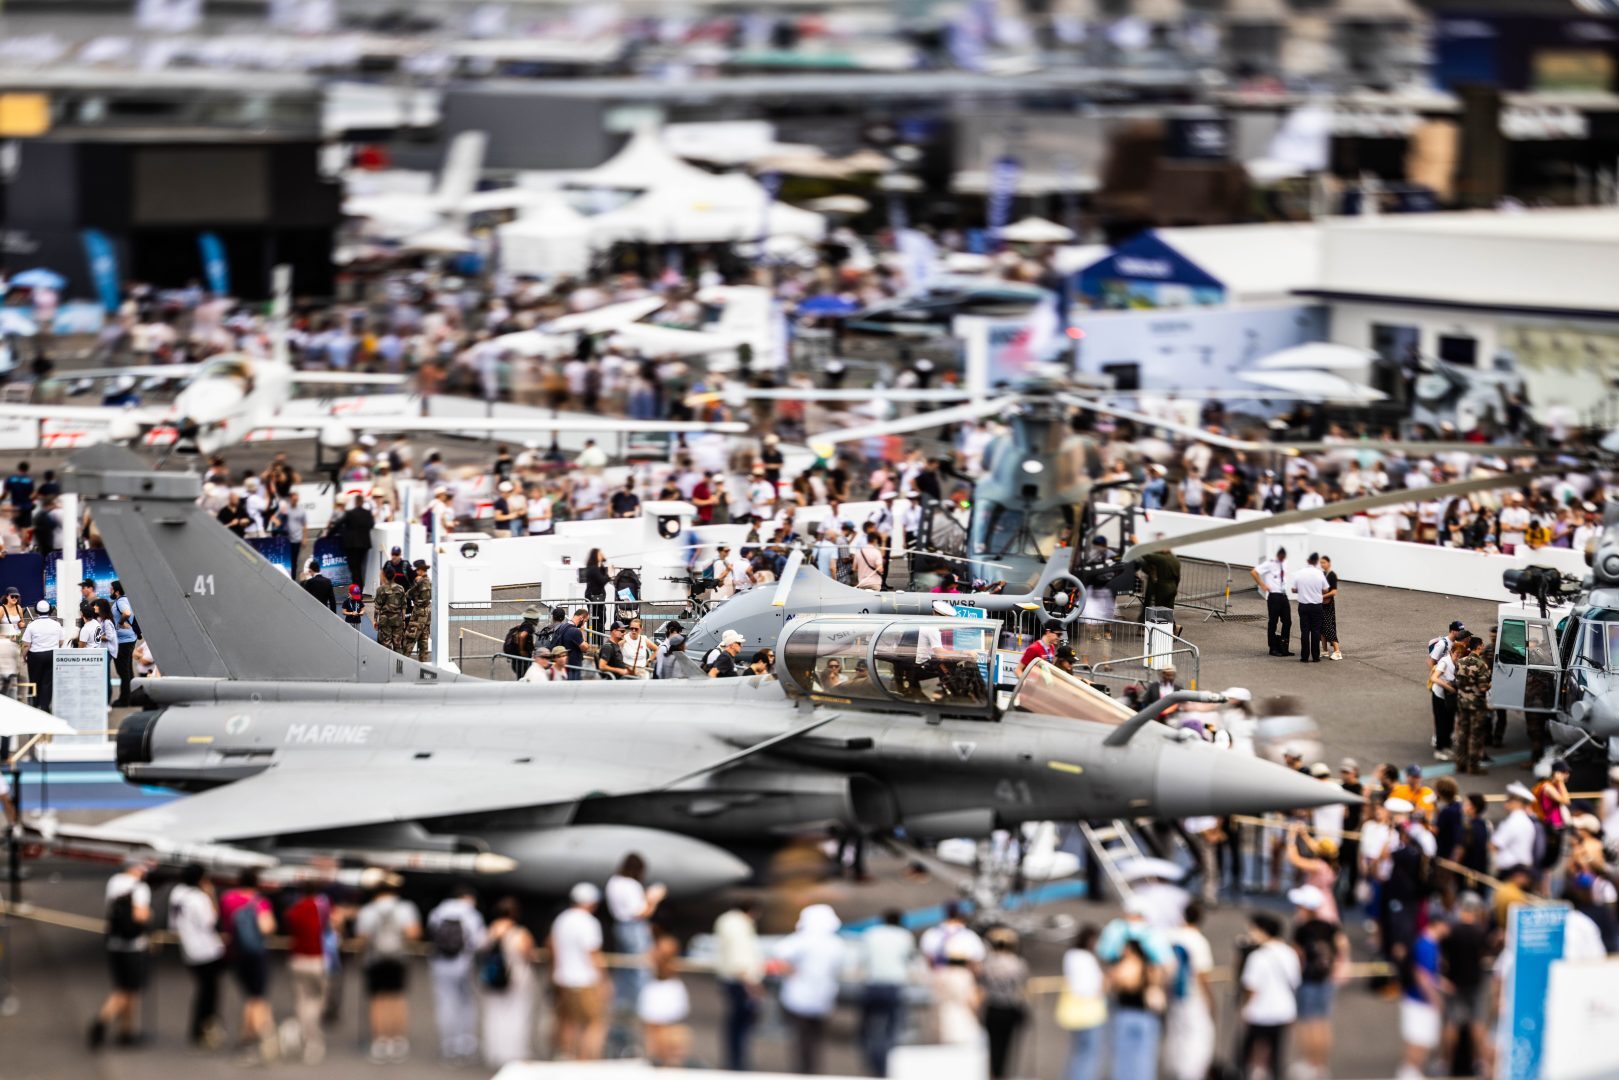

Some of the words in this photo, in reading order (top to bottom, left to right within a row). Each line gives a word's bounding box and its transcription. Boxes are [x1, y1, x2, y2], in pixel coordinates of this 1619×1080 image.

[193, 574, 215, 596] 41
[284, 723, 373, 744] MARINE
[993, 778, 1033, 805] 41
